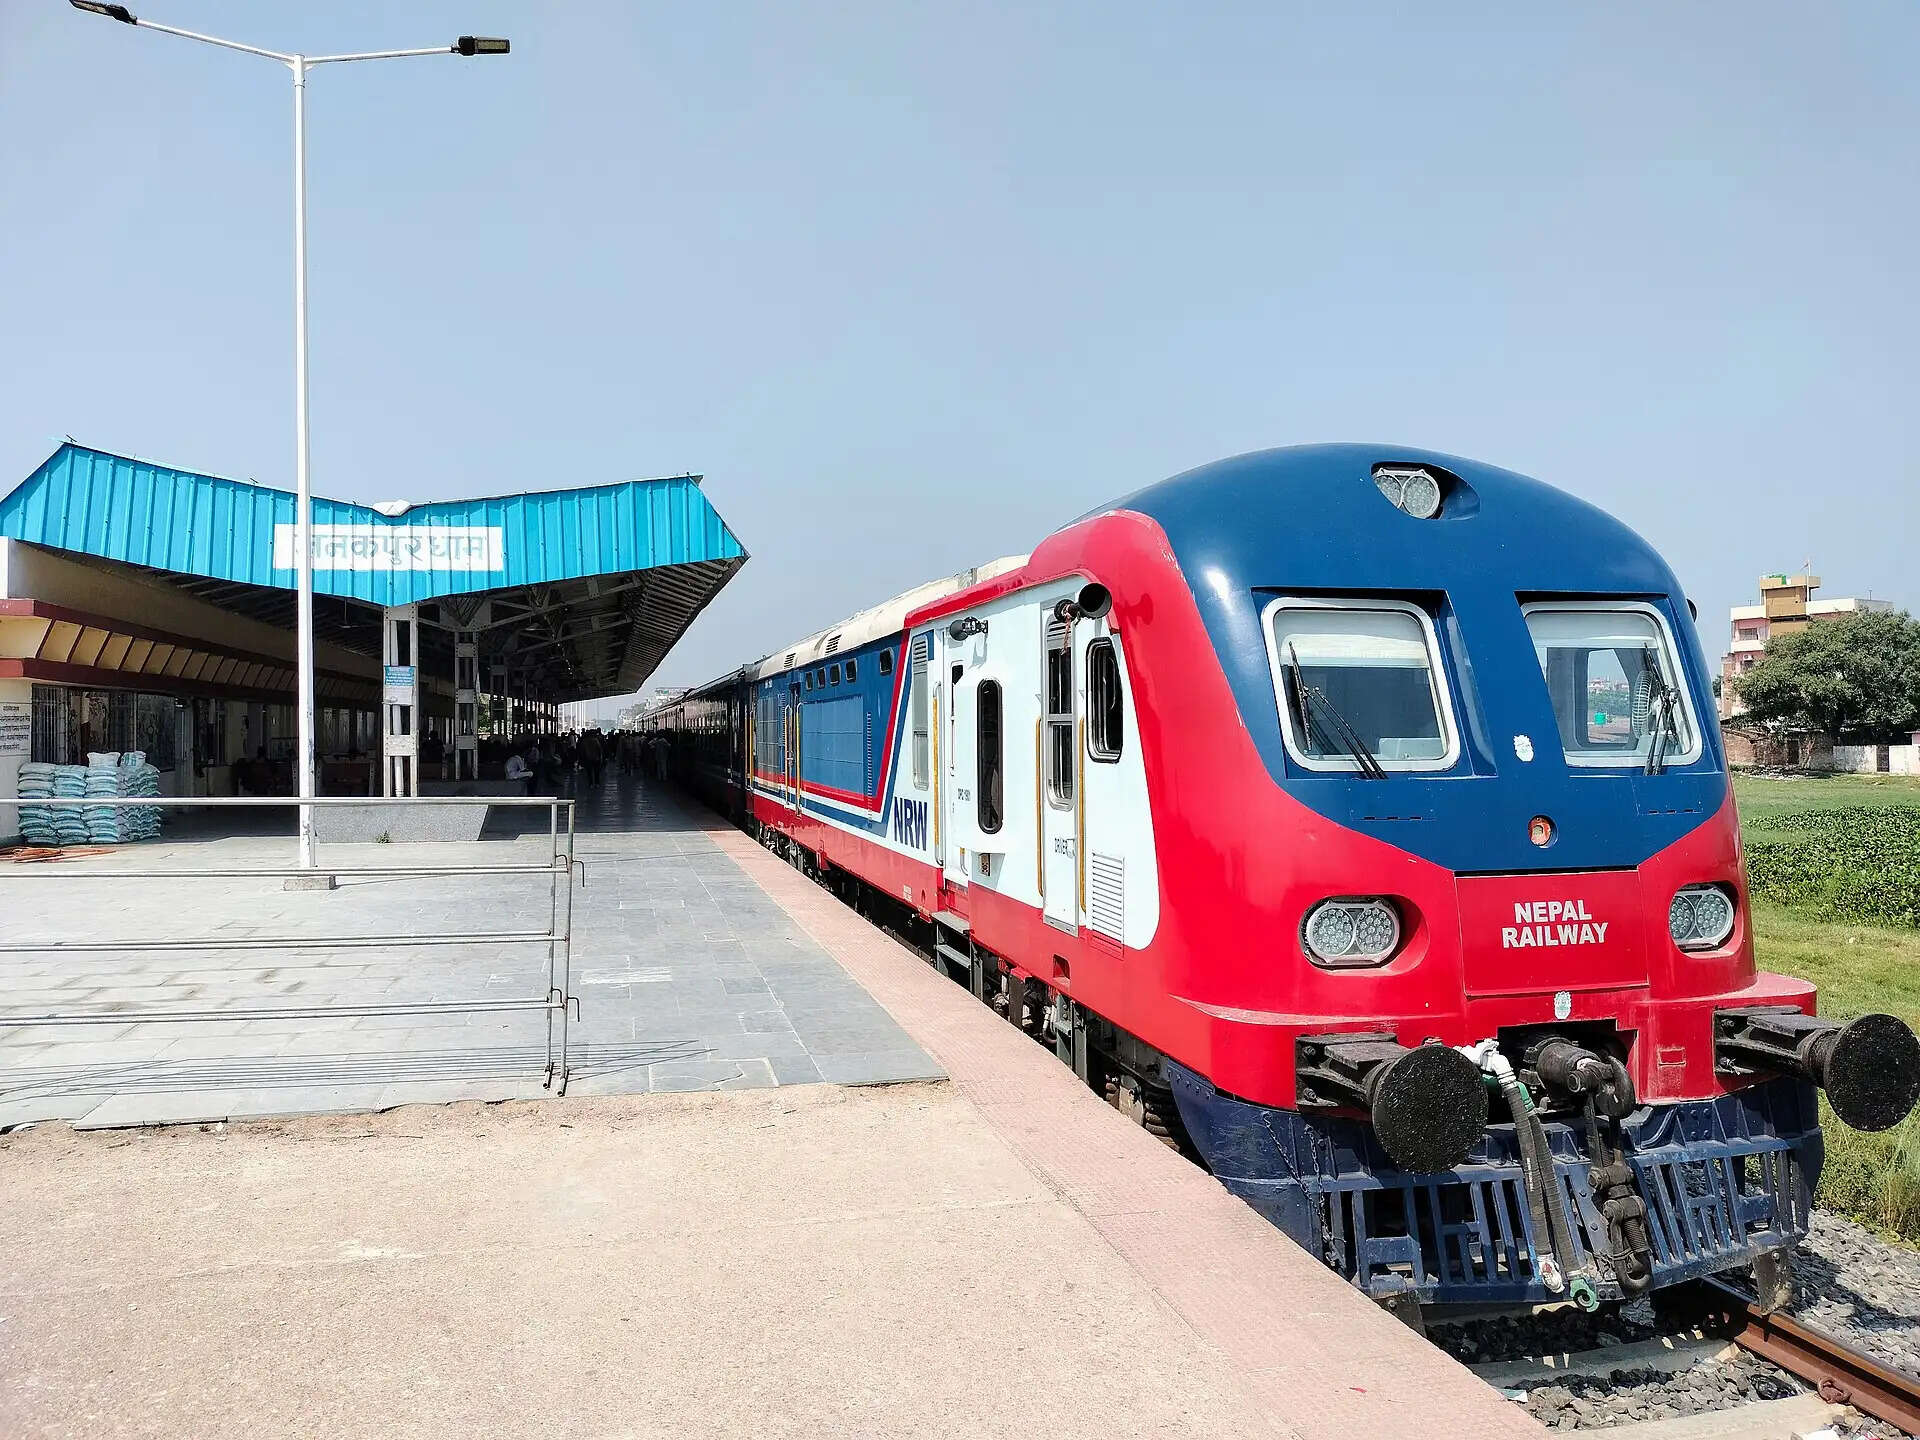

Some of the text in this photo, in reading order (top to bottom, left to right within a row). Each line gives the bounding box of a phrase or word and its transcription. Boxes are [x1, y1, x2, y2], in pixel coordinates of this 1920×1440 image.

[894, 796, 928, 851] NRW
[1514, 899, 1592, 923] NEPAL
[1501, 922, 1608, 948] RAILWAY
